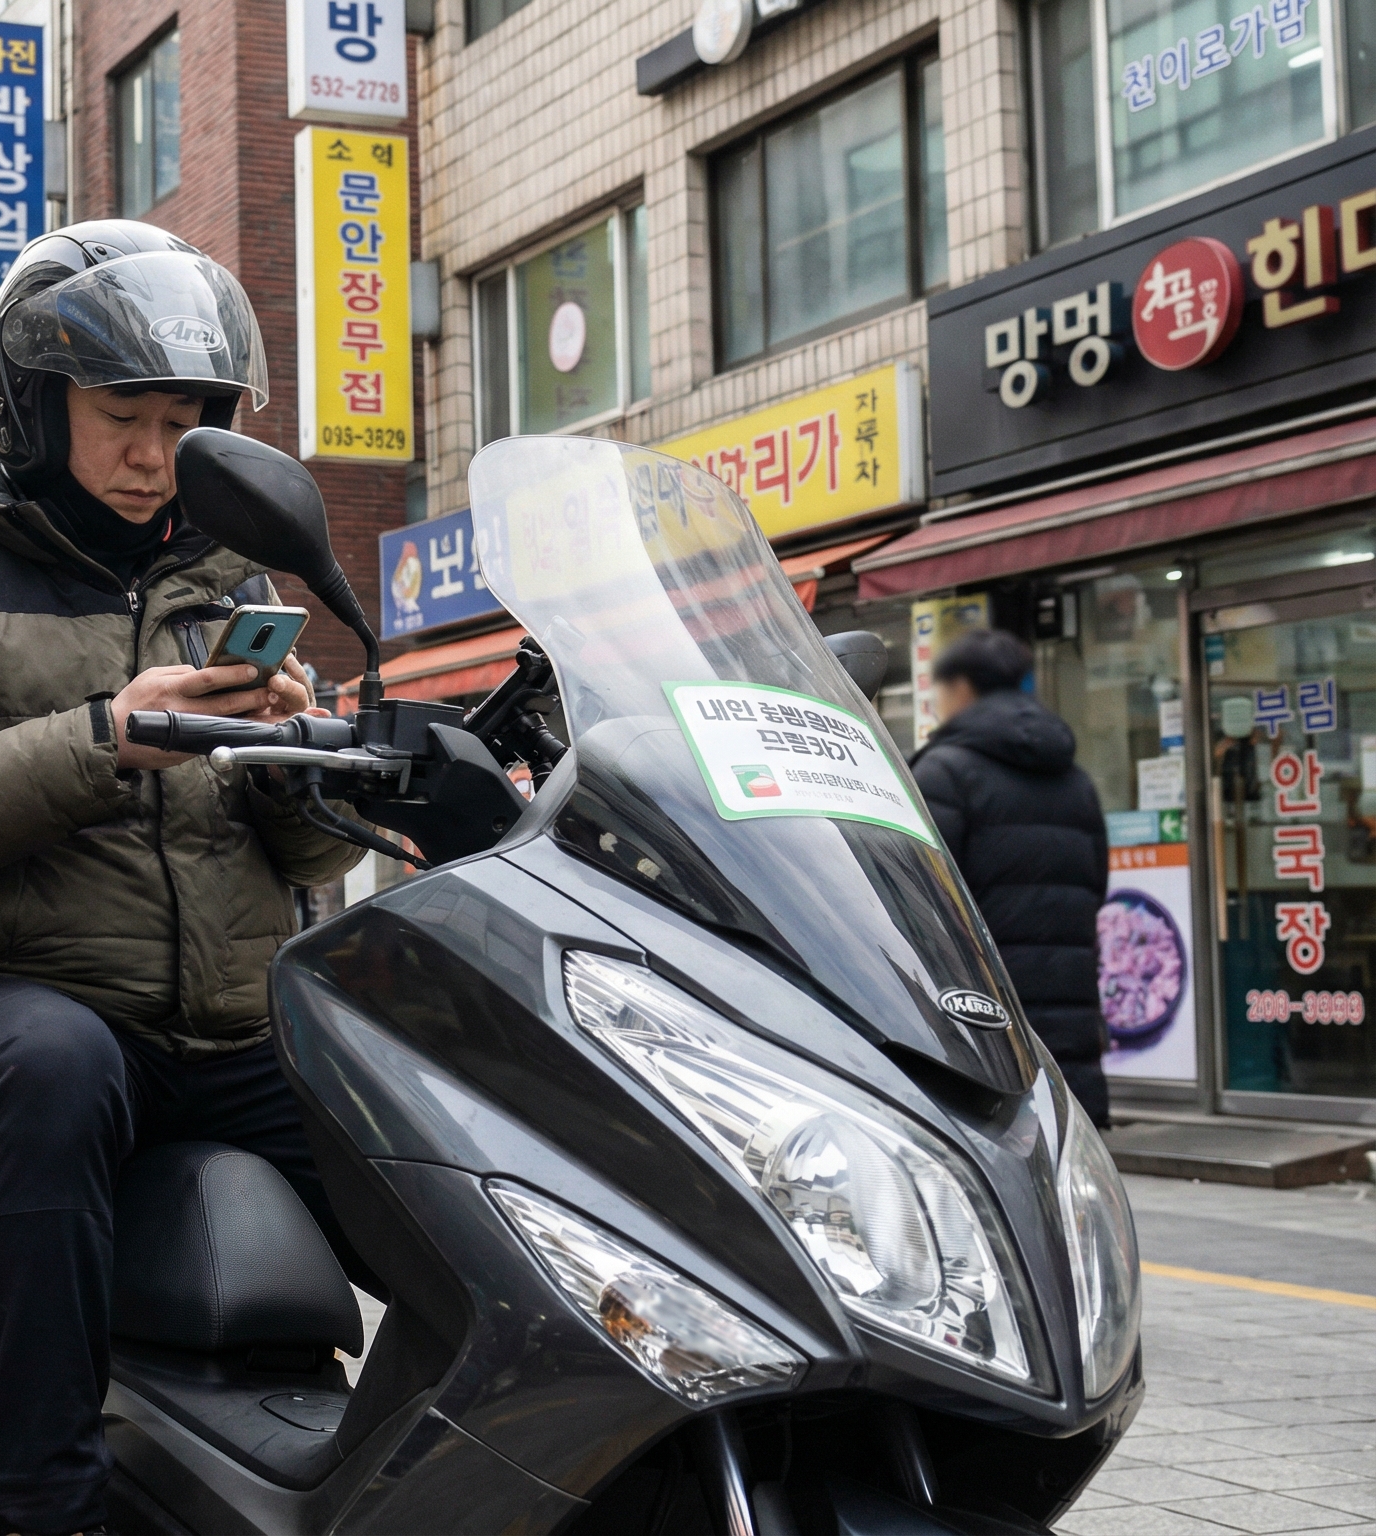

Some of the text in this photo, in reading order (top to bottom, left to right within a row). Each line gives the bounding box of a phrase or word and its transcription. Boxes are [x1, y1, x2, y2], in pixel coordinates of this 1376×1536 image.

[328, 1, 383, 63] 방
[310, 75, 401, 104] 532-2728
[985, 281, 1113, 408] 망멍
[696, 699, 758, 721] 내인
[1254, 680, 1335, 736] 부림
[1273, 750, 1330, 974] 안국장
